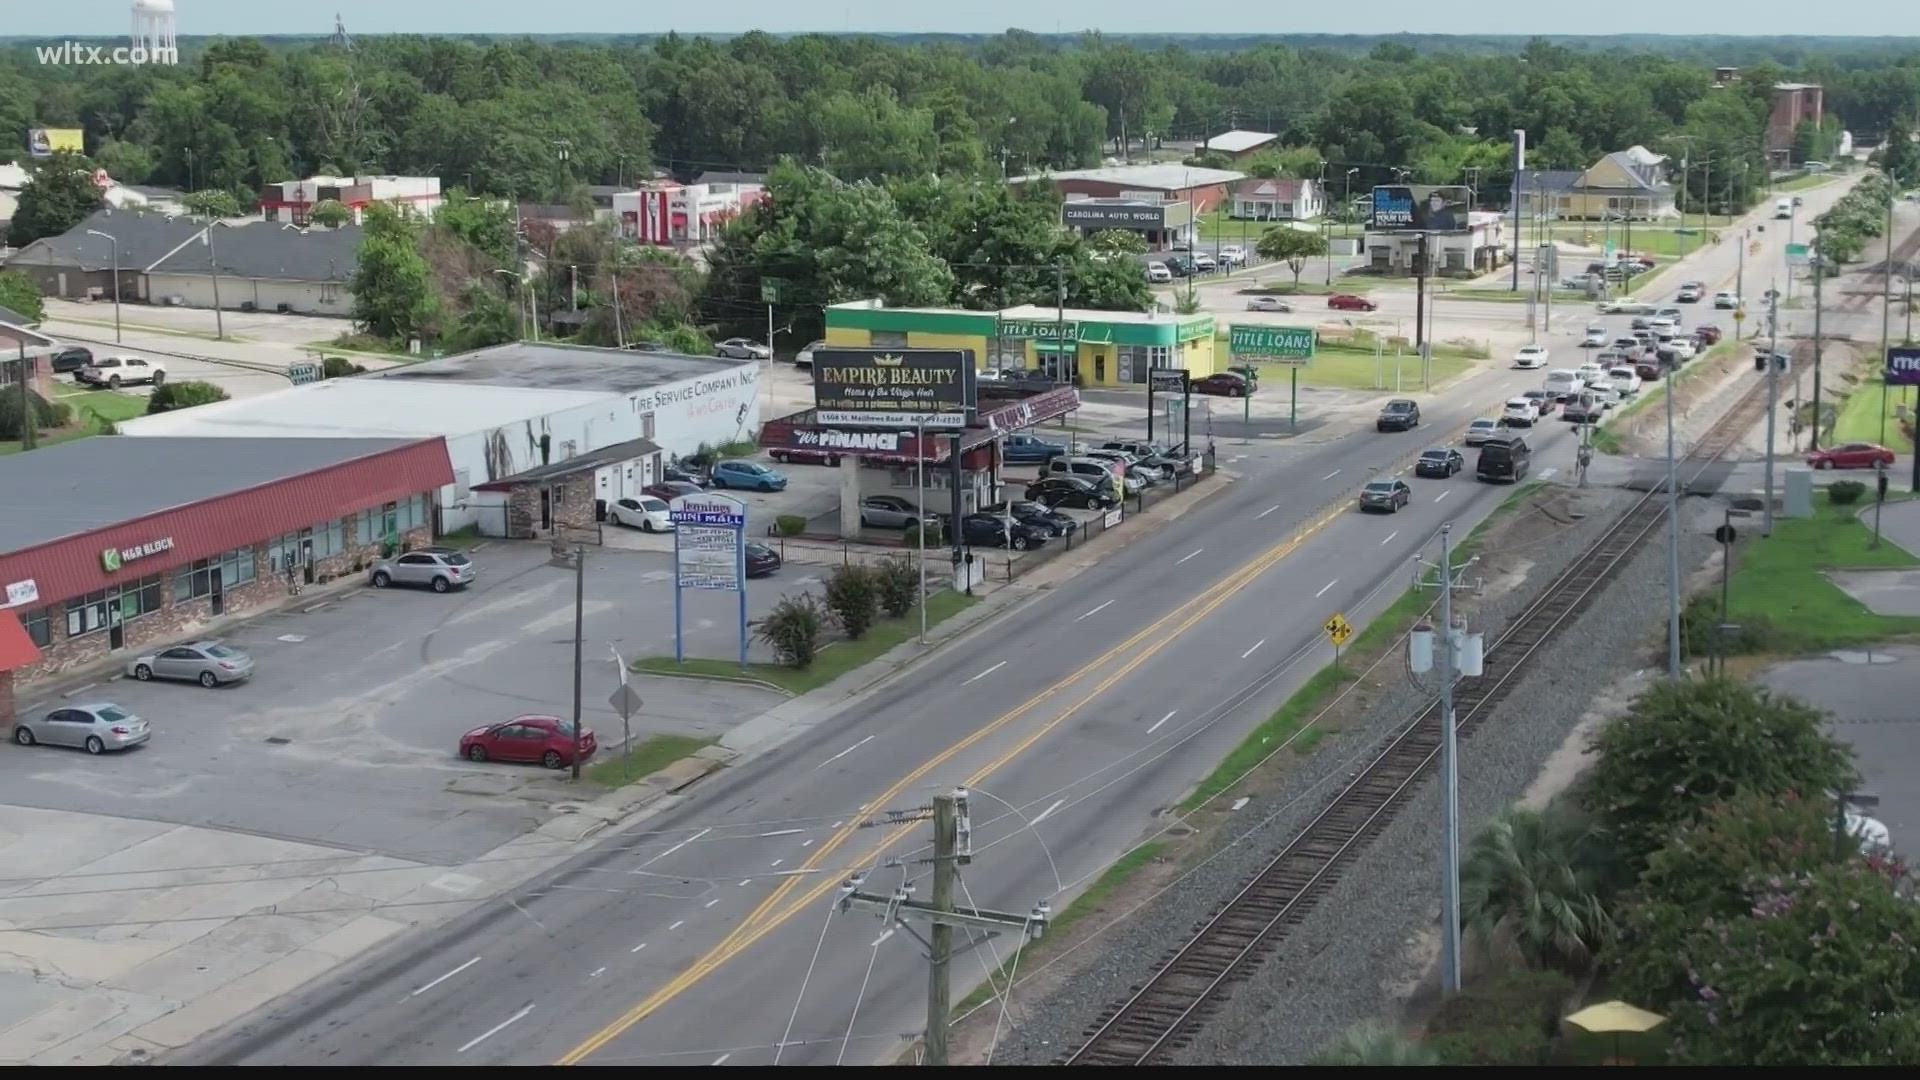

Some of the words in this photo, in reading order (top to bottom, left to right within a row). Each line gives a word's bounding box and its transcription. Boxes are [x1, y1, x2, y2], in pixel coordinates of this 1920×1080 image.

[1067, 211, 1105, 219] CAROLINA
[1109, 212, 1129, 220] AUTO
[1232, 332, 1264, 346] TITLE
[1268, 334, 1311, 349] LOANS
[822, 367, 886, 385] EMPIRE
[890, 369, 956, 385] BEAUTY
[629, 396, 652, 413] TIRE
[655, 386, 693, 408] SERVICE
[694, 376, 738, 397] COMPANY
[797, 431, 818, 445] We
[818, 431, 898, 450] FINANCE
[682, 500, 732, 514] Jennings
[671, 513, 702, 522] MINI
[705, 515, 742, 525] MALL
[122, 545, 144, 562] H&R
[144, 537, 175, 556] BLOCK
